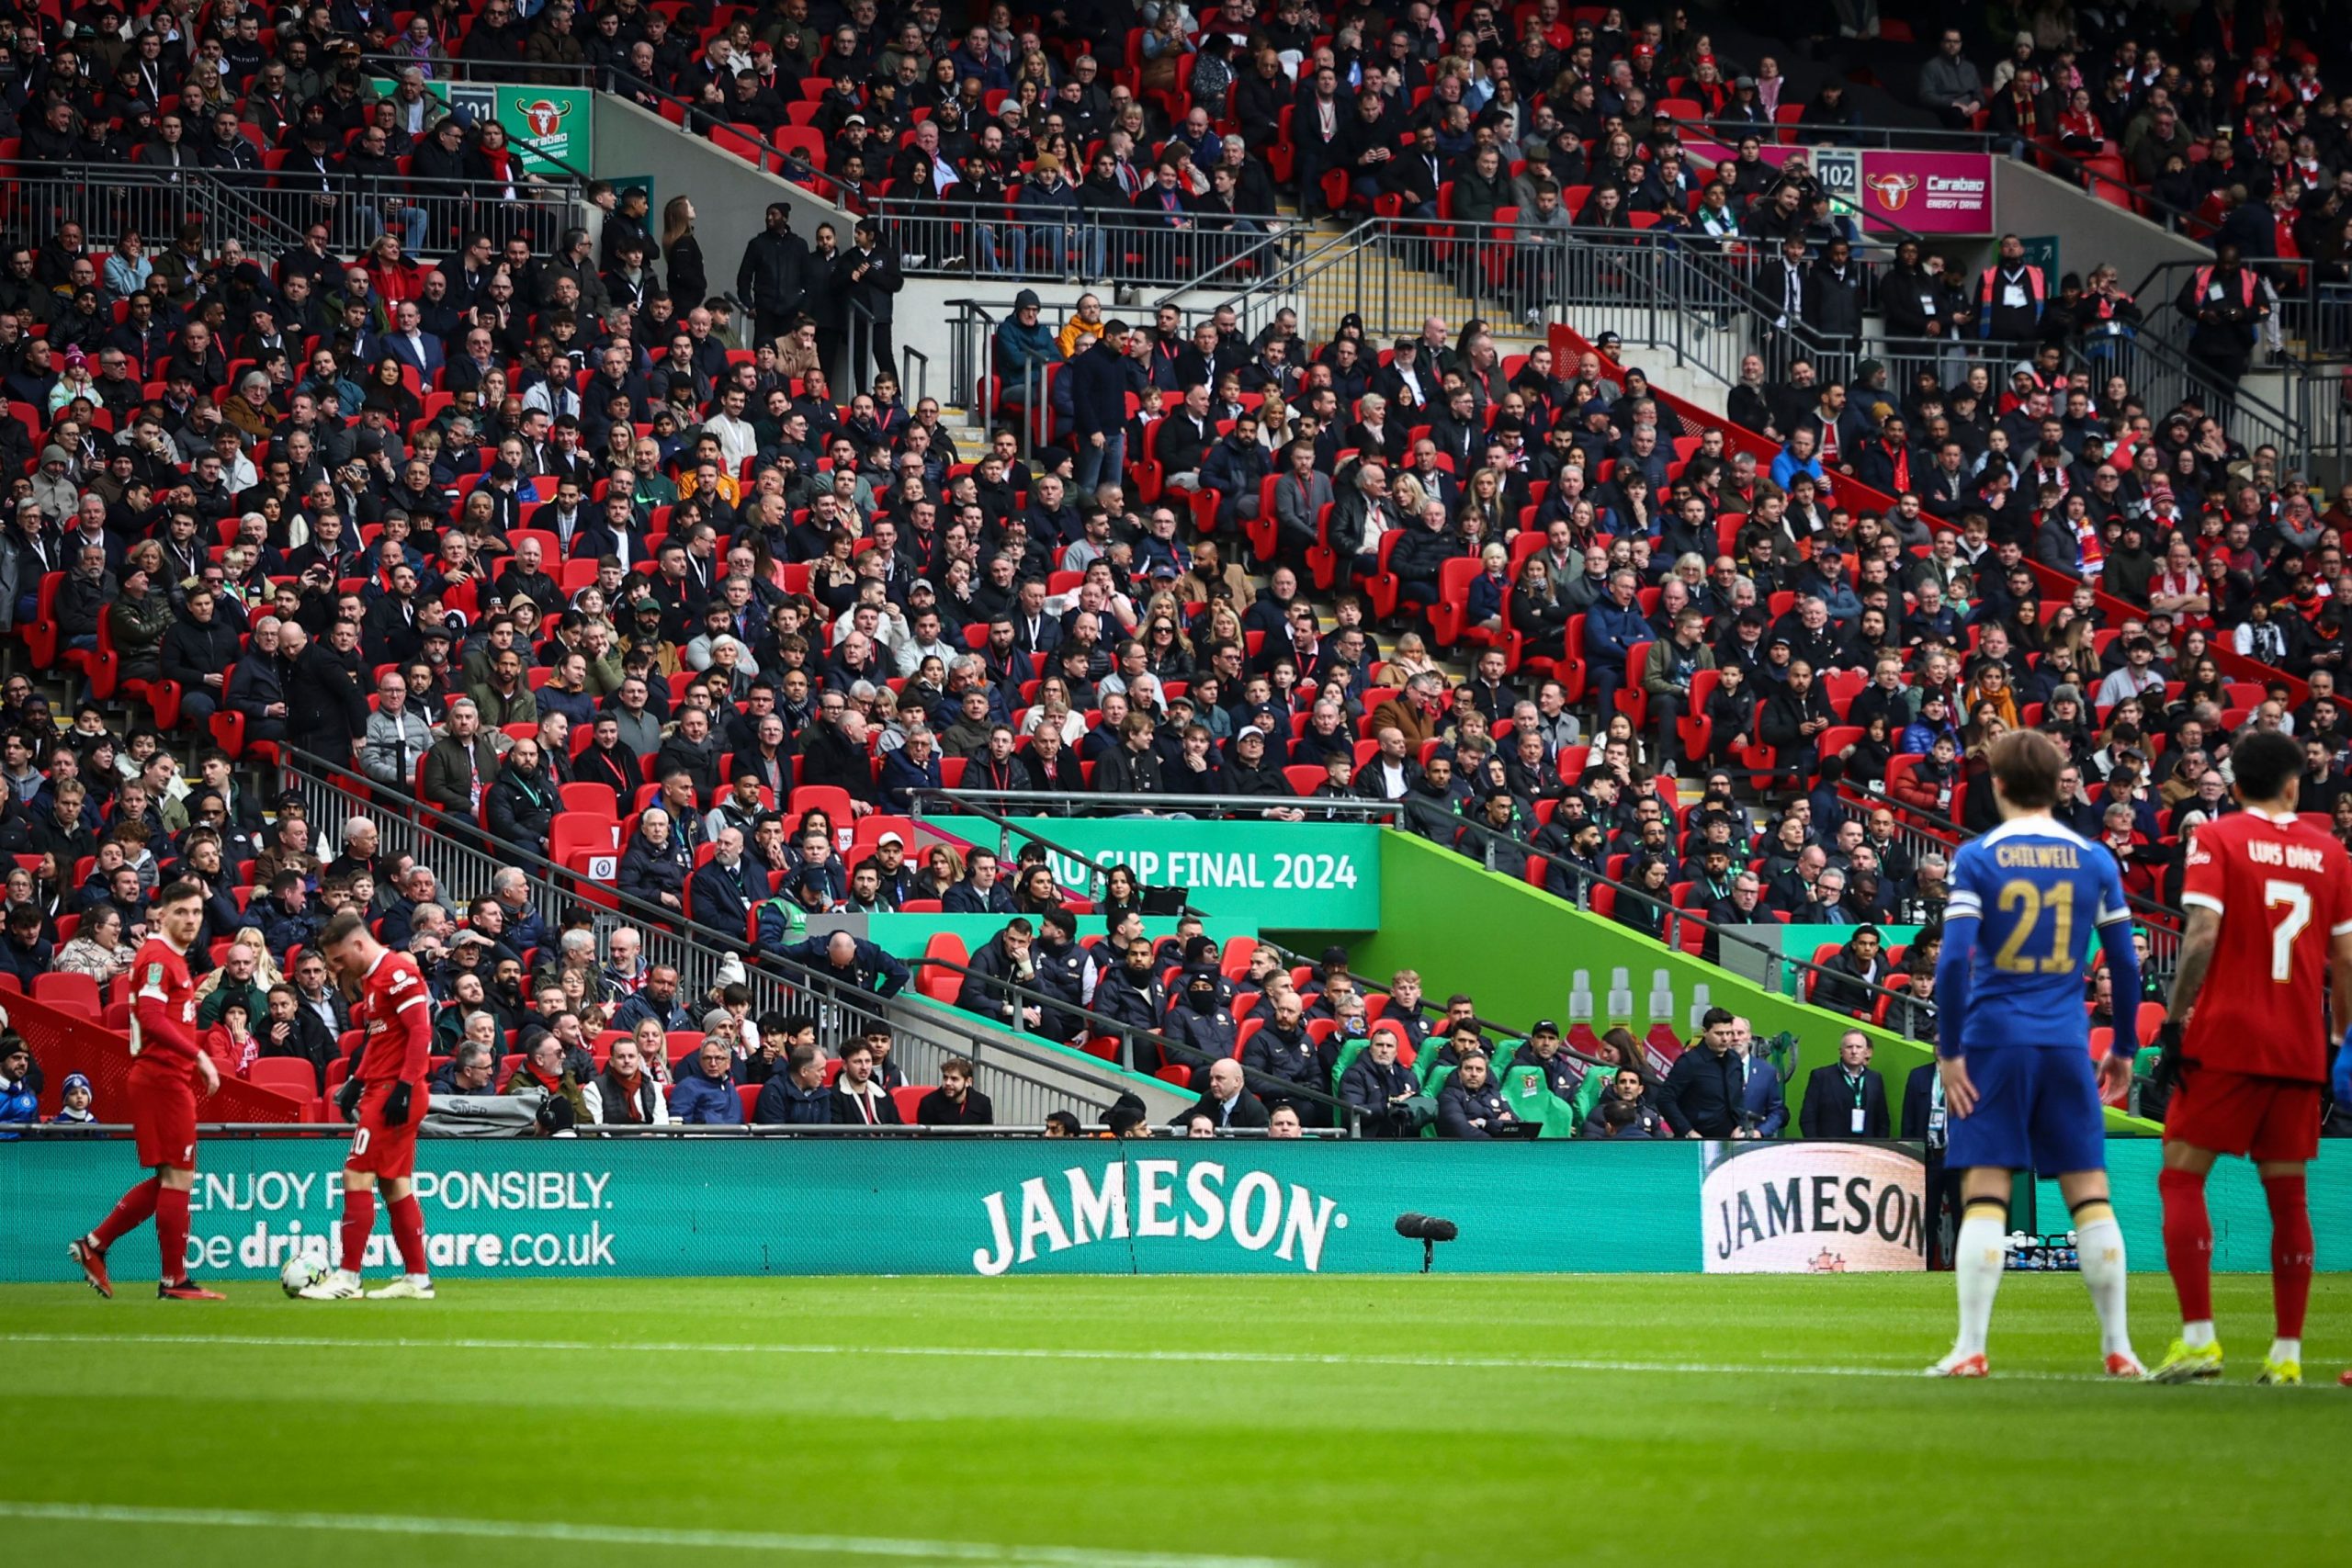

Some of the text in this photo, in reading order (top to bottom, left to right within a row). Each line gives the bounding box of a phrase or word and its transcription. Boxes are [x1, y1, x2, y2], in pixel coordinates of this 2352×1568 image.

[456, 102, 490, 121] 01
[1819, 164, 1853, 186] 102
[1927, 175, 1985, 192] Carabao
[1927, 199, 1982, 210] ENERGY DRINK
[1996, 842, 2081, 870] CHILWELL
[2247, 839, 2284, 866] LUIS
[1168, 852, 1264, 887] FINAL
[1272, 853, 1358, 889] 2024
[1994, 879, 2075, 975] 21
[2265, 879, 2312, 984] 7
[326, 1170, 615, 1210] PONSIBLY.
[972, 1159, 1338, 1276] JAMESON
[1717, 1175, 1926, 1260] JAMESON
